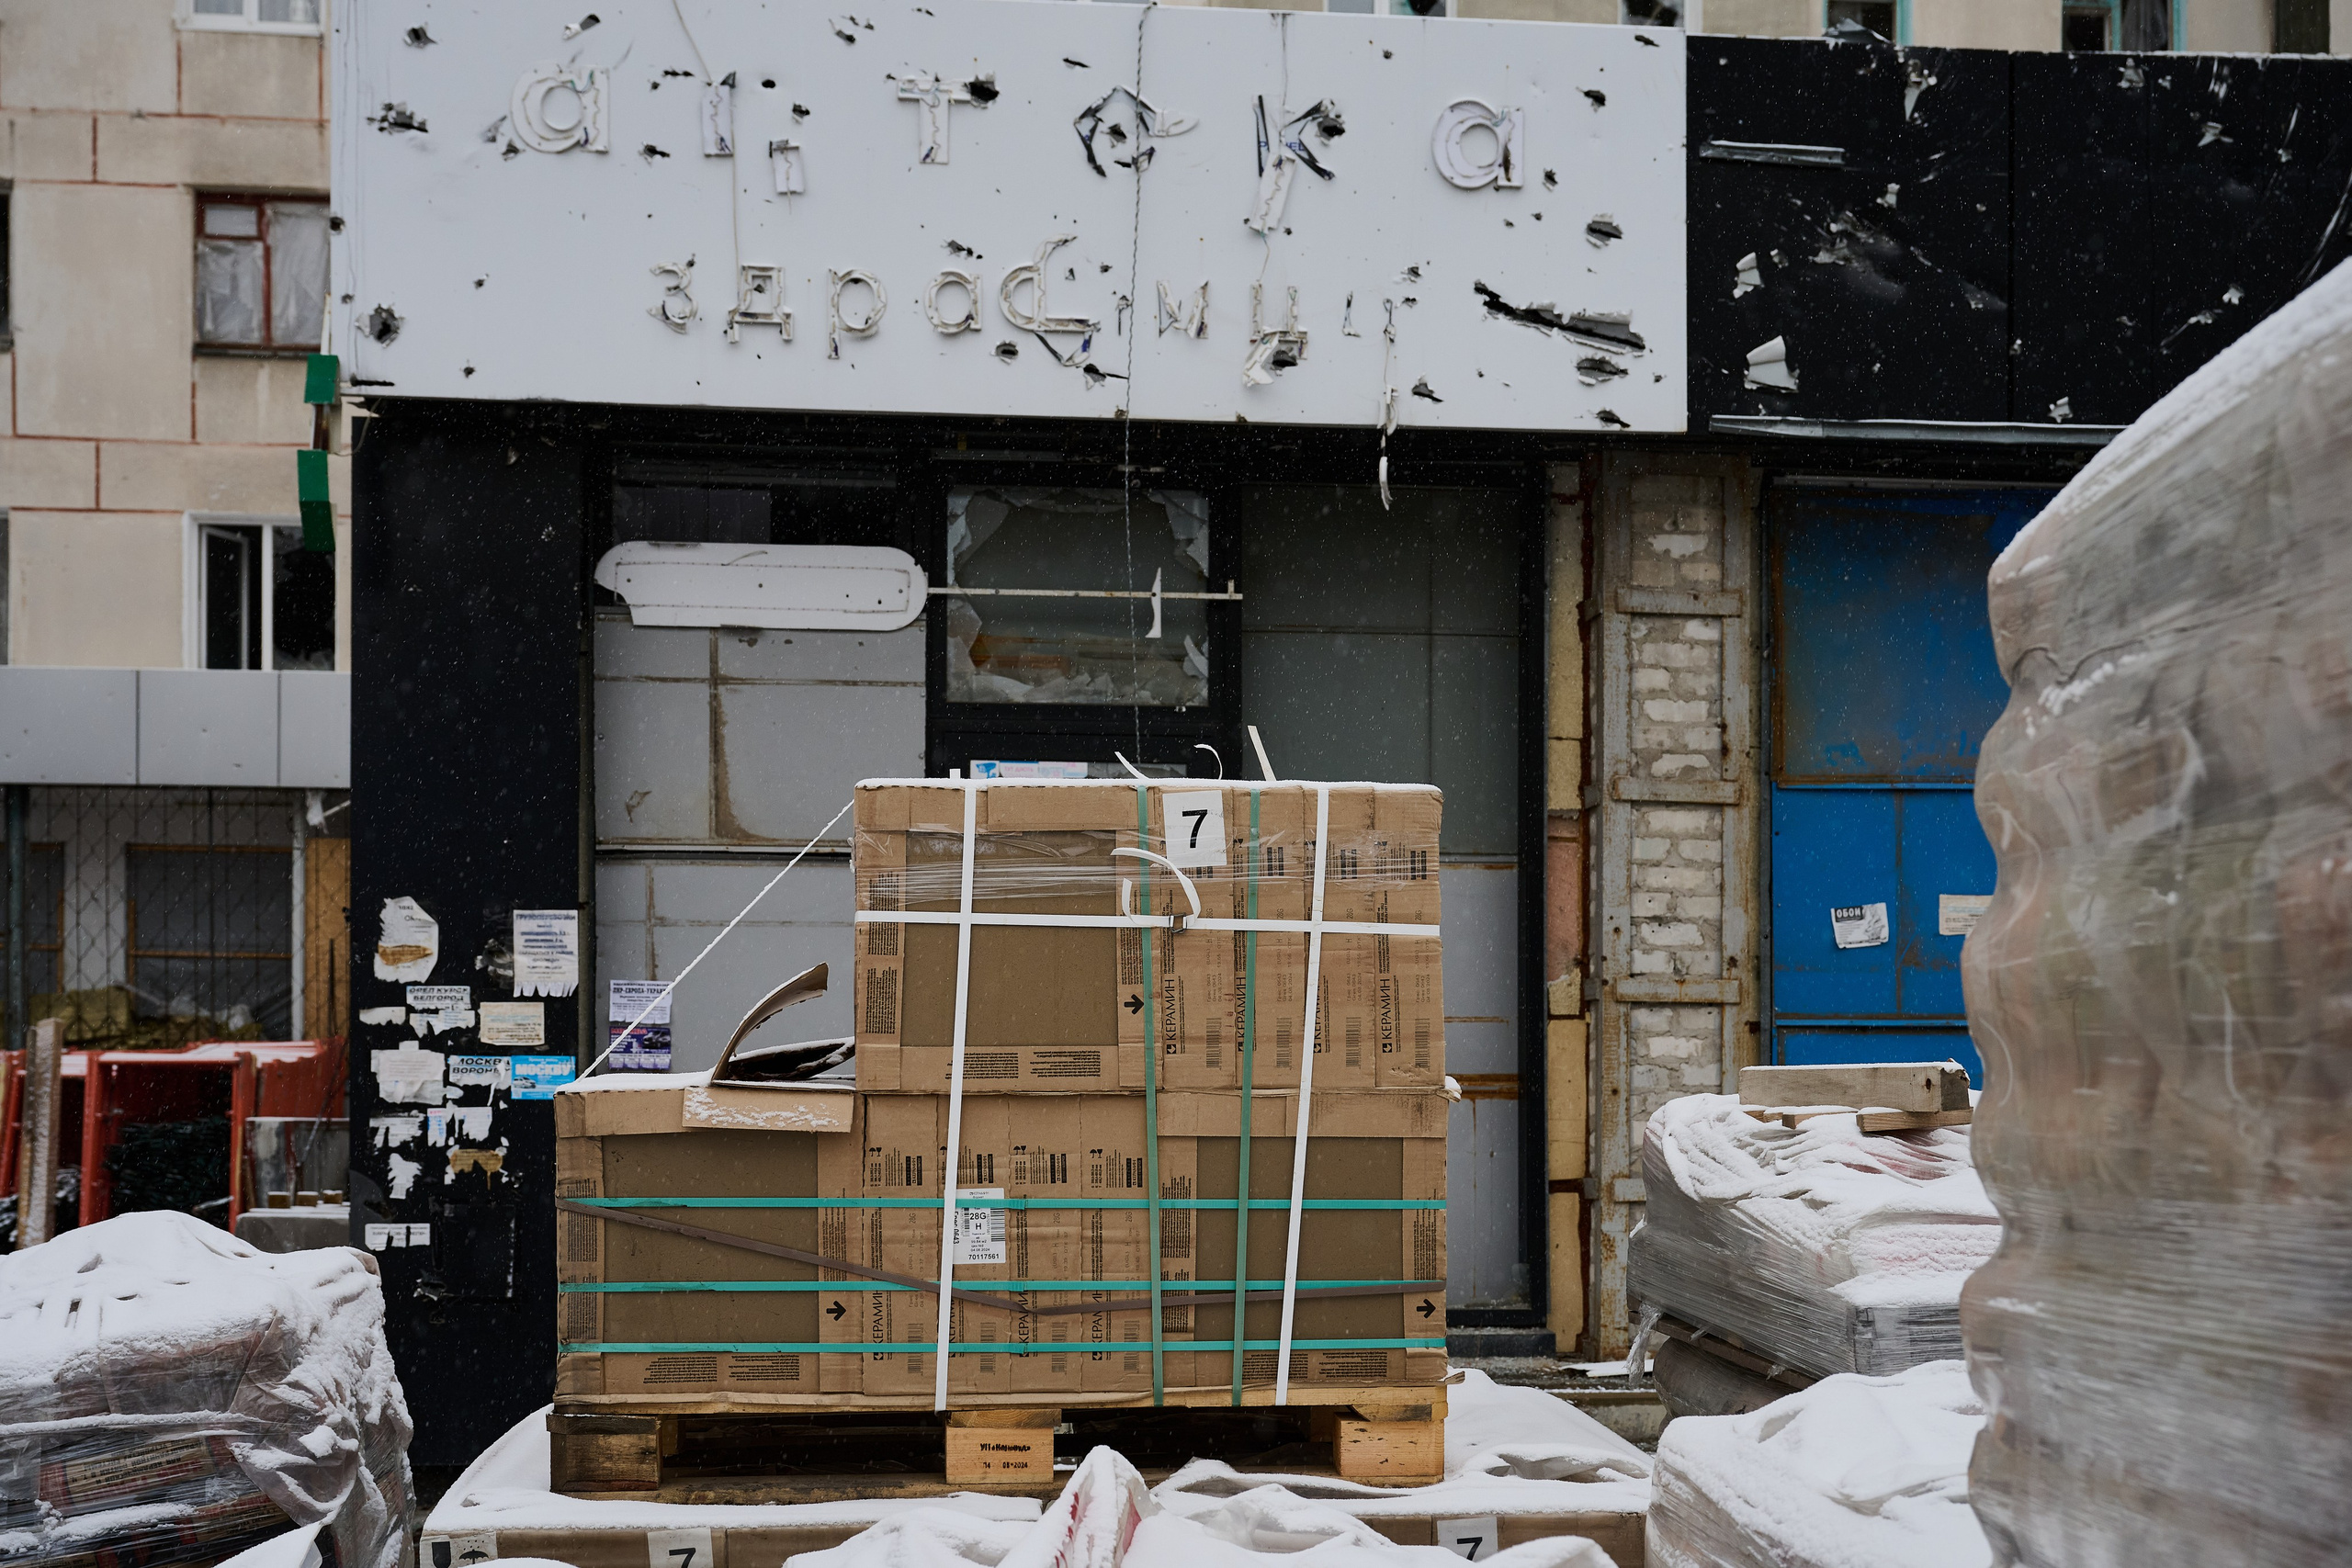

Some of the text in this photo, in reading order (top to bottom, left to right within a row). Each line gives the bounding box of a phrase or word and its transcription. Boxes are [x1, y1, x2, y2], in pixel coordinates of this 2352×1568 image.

[511, 67, 1525, 195] атка
[1182, 809, 1207, 849] 7
[1836, 908, 1861, 919] ОБОИ
[1165, 979, 1176, 1041] КЕРАМИН
[1380, 978, 1392, 1040] КЕРАМИН
[515, 1064, 571, 1076] МОСКВУ
[1019, 1291, 1029, 1343] КЕРАИ
[1457, 1536, 1483, 1561] 7
